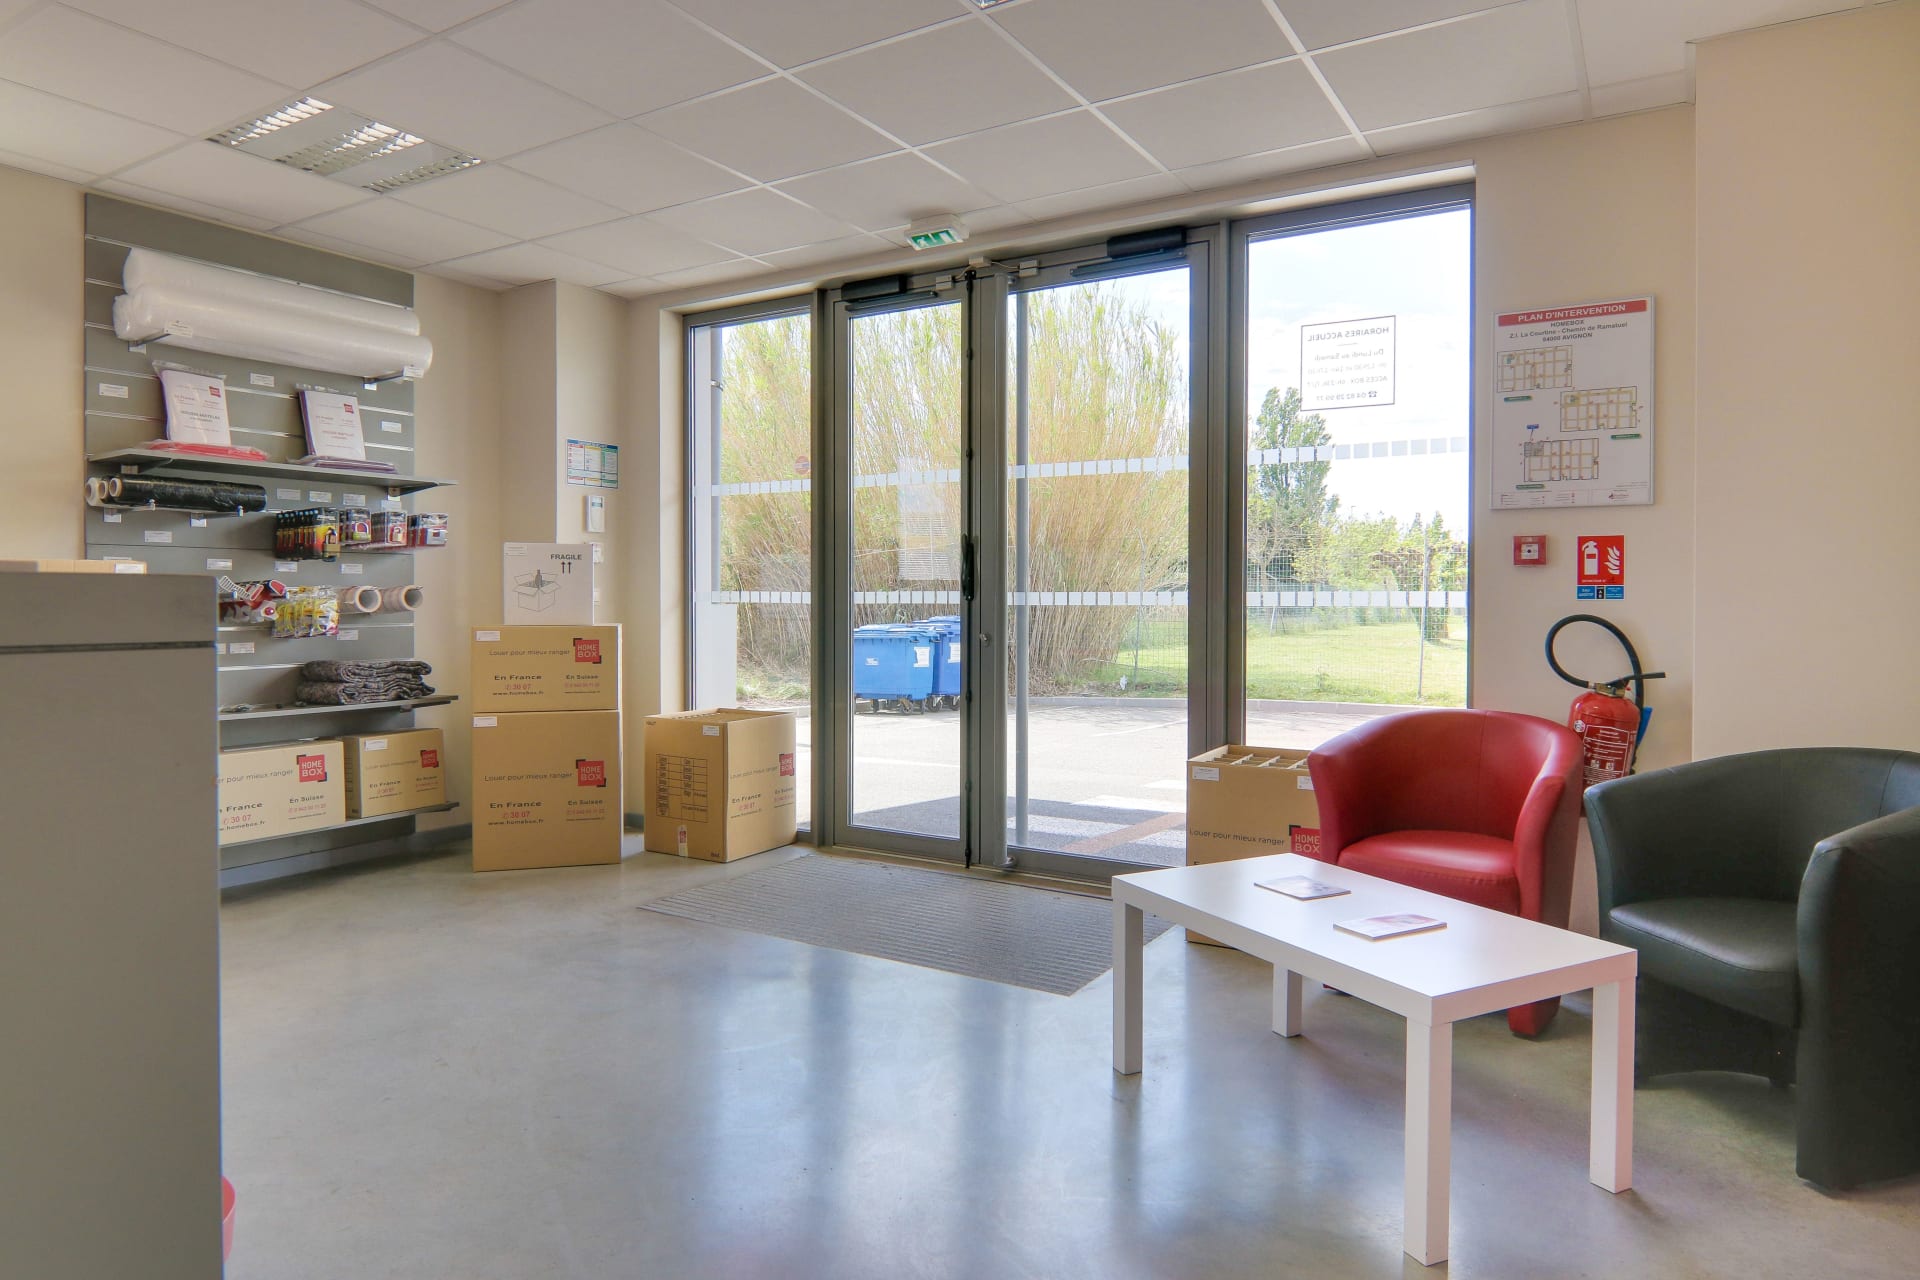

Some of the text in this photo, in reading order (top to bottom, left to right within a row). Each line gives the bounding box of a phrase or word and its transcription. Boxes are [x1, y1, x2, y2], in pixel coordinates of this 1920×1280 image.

[1518, 304, 1626, 323] PLAN D'INTERVENTION
[1550, 319, 1585, 328] HOMEBOX
[1561, 325, 1586, 334] Chemin
[1562, 332, 1593, 341] AVIGNON
[550, 553, 582, 561] FRAGILE
[577, 643, 597, 651] HOME
[548, 648, 570, 657] ranger
[577, 650, 598, 658] BOX
[509, 673, 542, 681] France
[301, 759, 323, 769] HOME
[301, 768, 323, 777] BOX
[580, 765, 601, 774] HOME
[226, 775, 244, 784] pour
[246, 773, 269, 781] mieux
[270, 769, 294, 778] ranger
[484, 771, 573, 782] Louer pour mieux ranger
[580, 773, 602, 782] BOX
[301, 794, 324, 802] Suisse
[226, 802, 263, 813] France
[230, 814, 252, 824] 30 07
[510, 811, 521, 819] 30
[488, 818, 544, 826] www.homebox.fr
[1189, 827, 1285, 846] Louer pour mieux ranger
[1295, 833, 1320, 845] HOME
[1295, 843, 1320, 854] BOX
